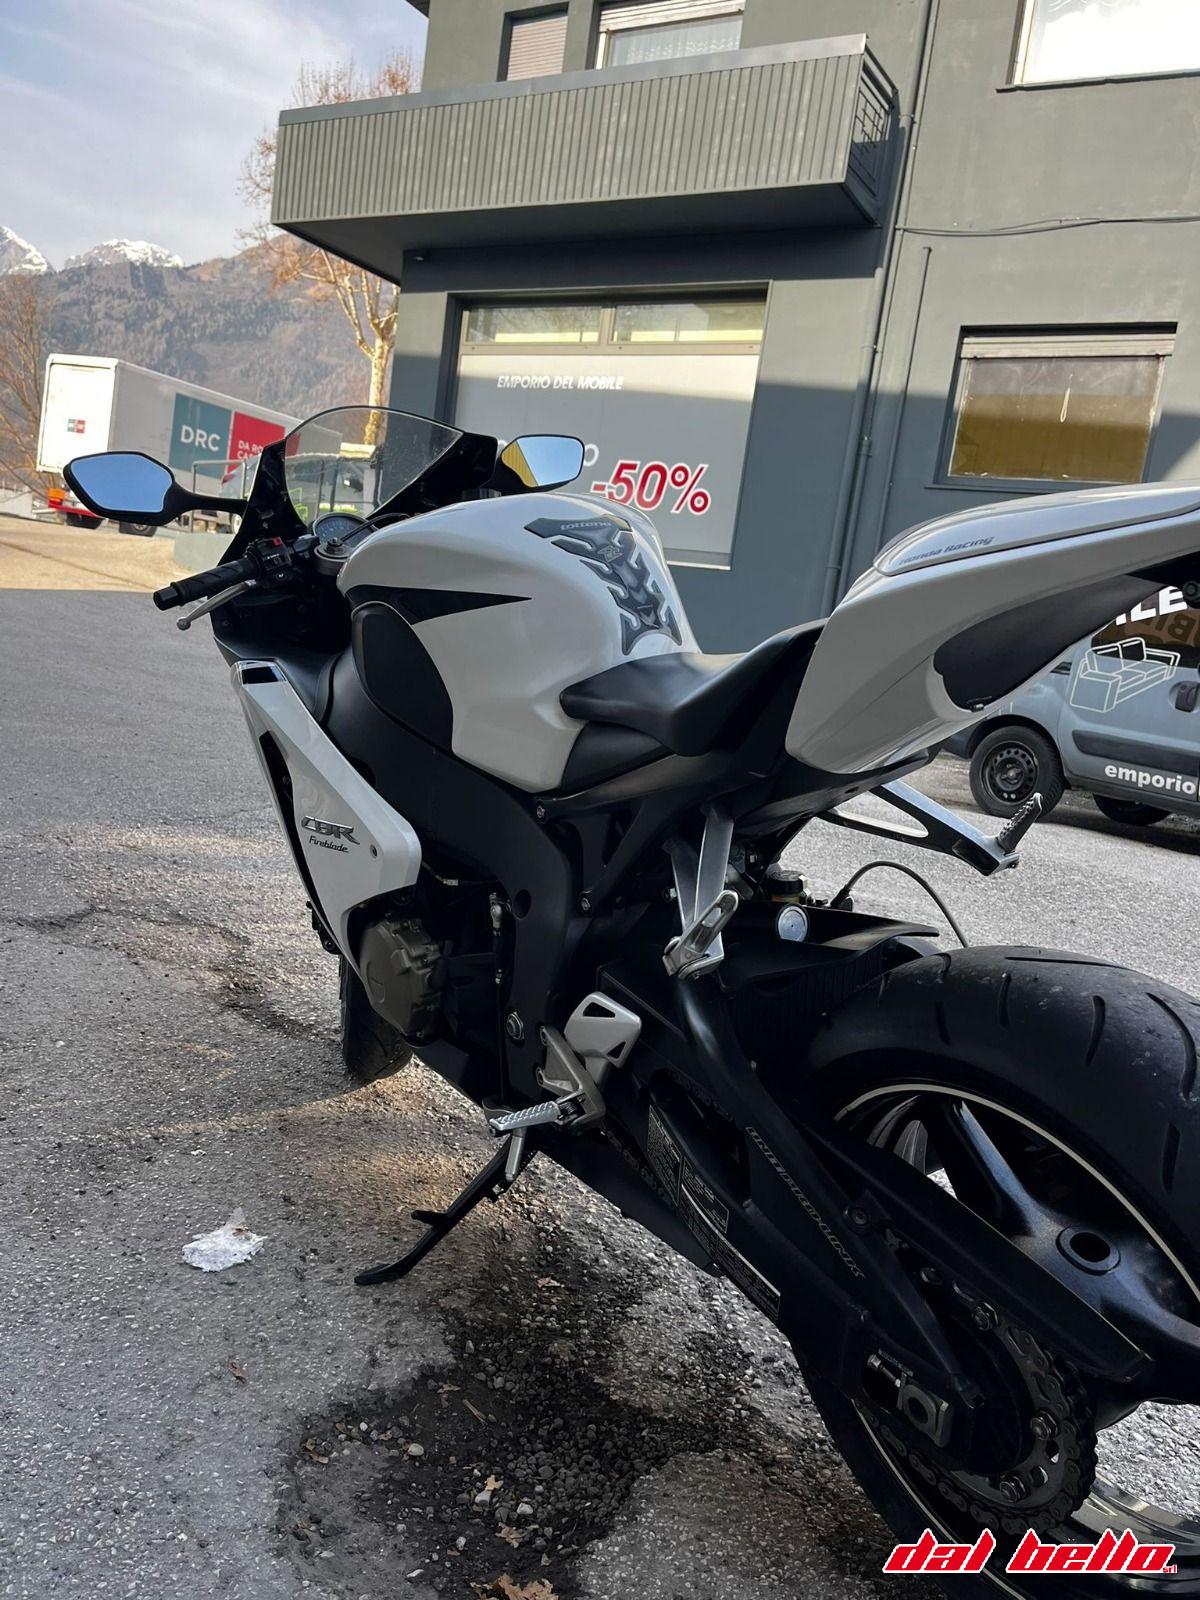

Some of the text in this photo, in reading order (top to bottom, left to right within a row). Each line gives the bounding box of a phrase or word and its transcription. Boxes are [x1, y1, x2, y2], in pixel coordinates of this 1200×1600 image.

[496, 375, 625, 391] EMPORIO DEL MOBILE
[180, 424, 221, 452] DRC
[590, 459, 711, 514] -50%
[943, 536, 994, 553] Racing
[1104, 764, 1197, 795] emporio
[301, 815, 361, 846] CBR
[308, 835, 349, 853] Fireblade
